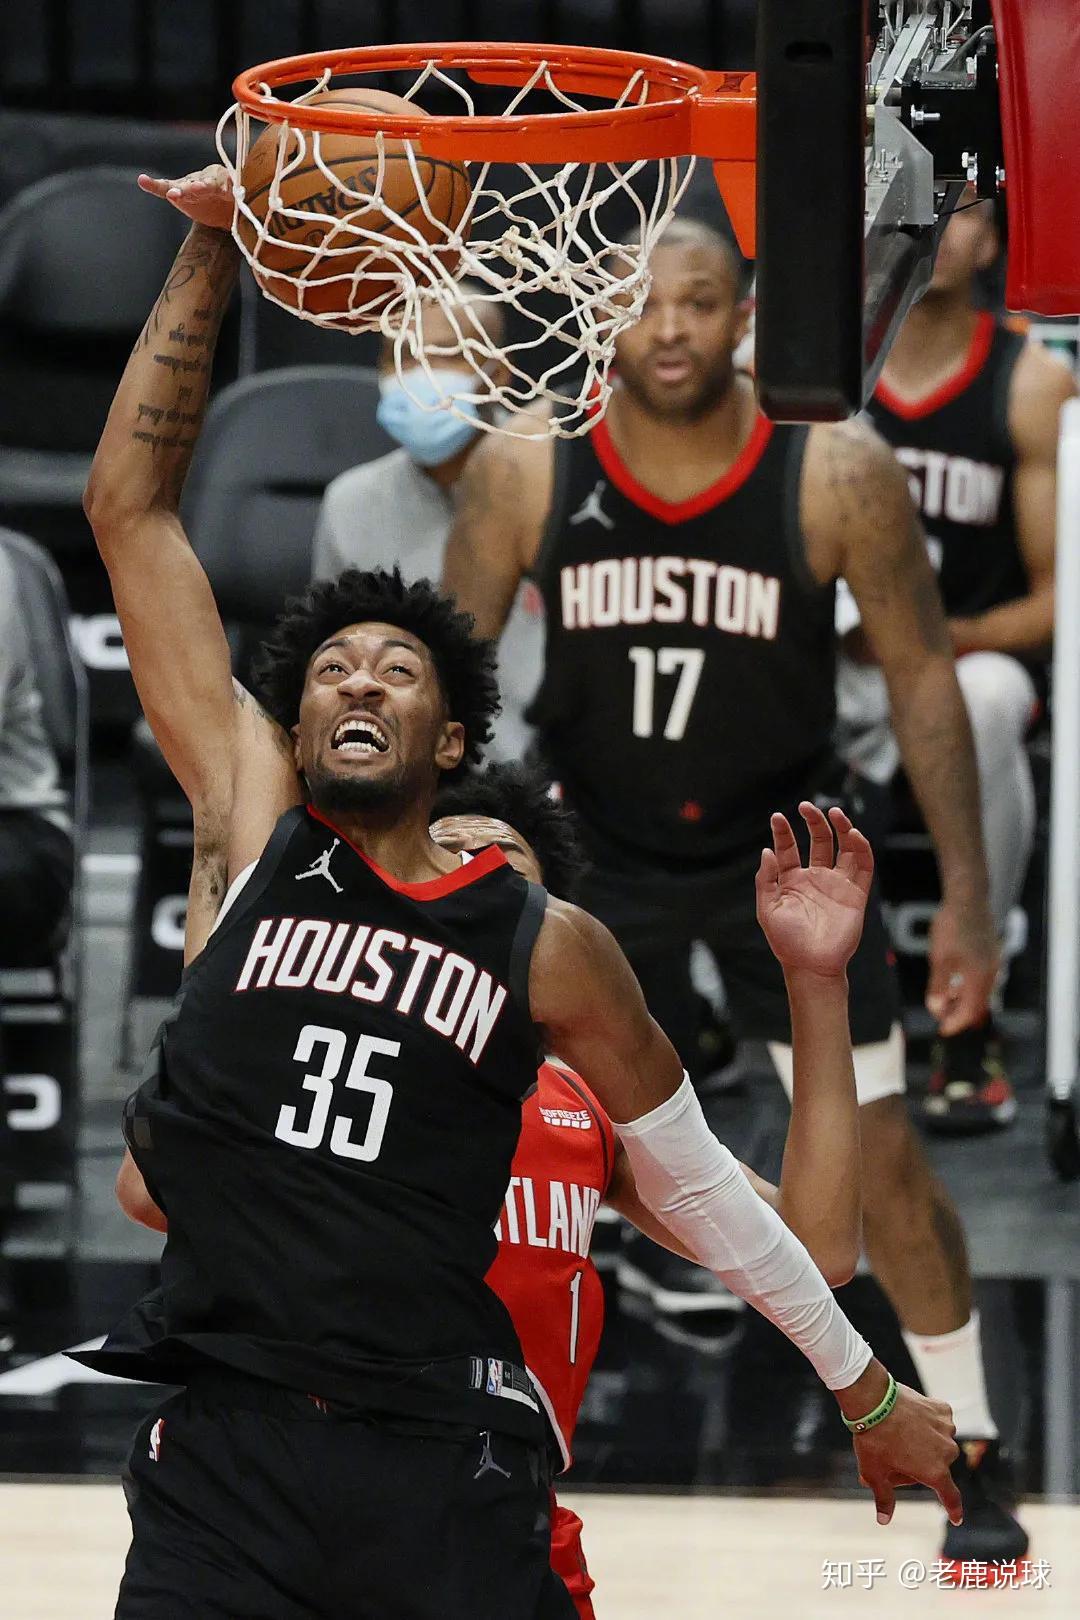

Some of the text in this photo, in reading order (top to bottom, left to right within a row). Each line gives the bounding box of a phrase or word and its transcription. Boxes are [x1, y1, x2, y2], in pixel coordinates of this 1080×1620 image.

[560, 555, 780, 640] HOUSTON
[628, 647, 705, 741] 17
[235, 917, 508, 1066] HOUSTON
[274, 1024, 402, 1162] 35
[493, 1176, 601, 1260] TLAND
[570, 1271, 583, 1364] 1
